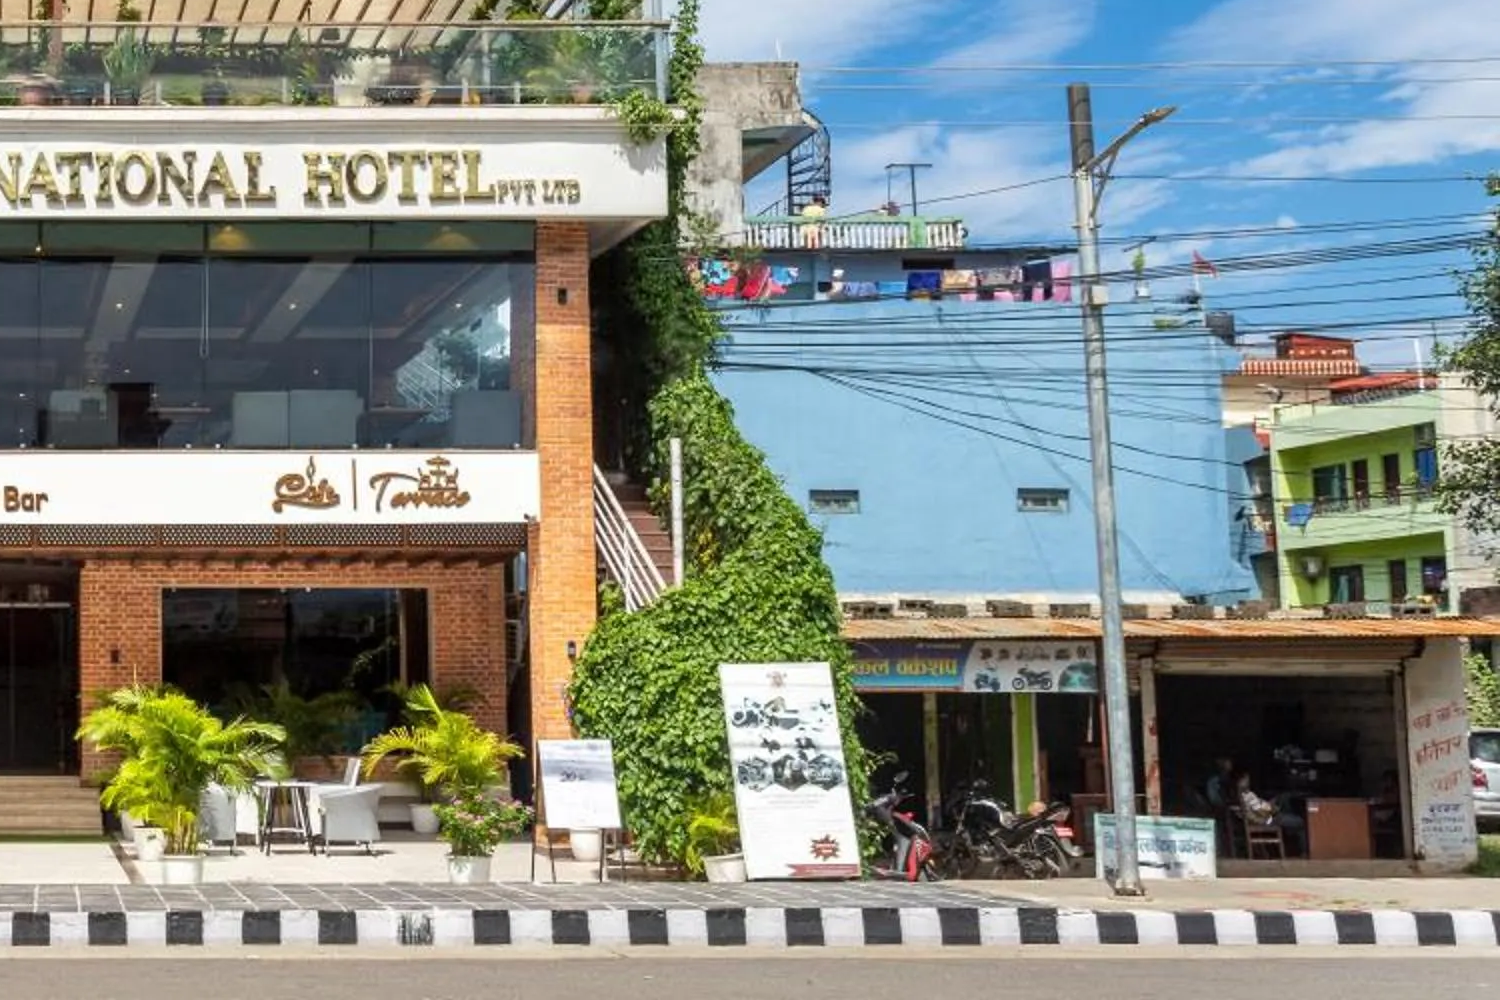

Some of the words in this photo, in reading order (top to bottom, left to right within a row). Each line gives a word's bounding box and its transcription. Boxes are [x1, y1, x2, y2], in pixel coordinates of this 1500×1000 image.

[302, 150, 496, 207] HOTEL
[497, 179, 536, 204] PVT
[542, 179, 580, 204] LTD
[3, 484, 50, 514] Bar
